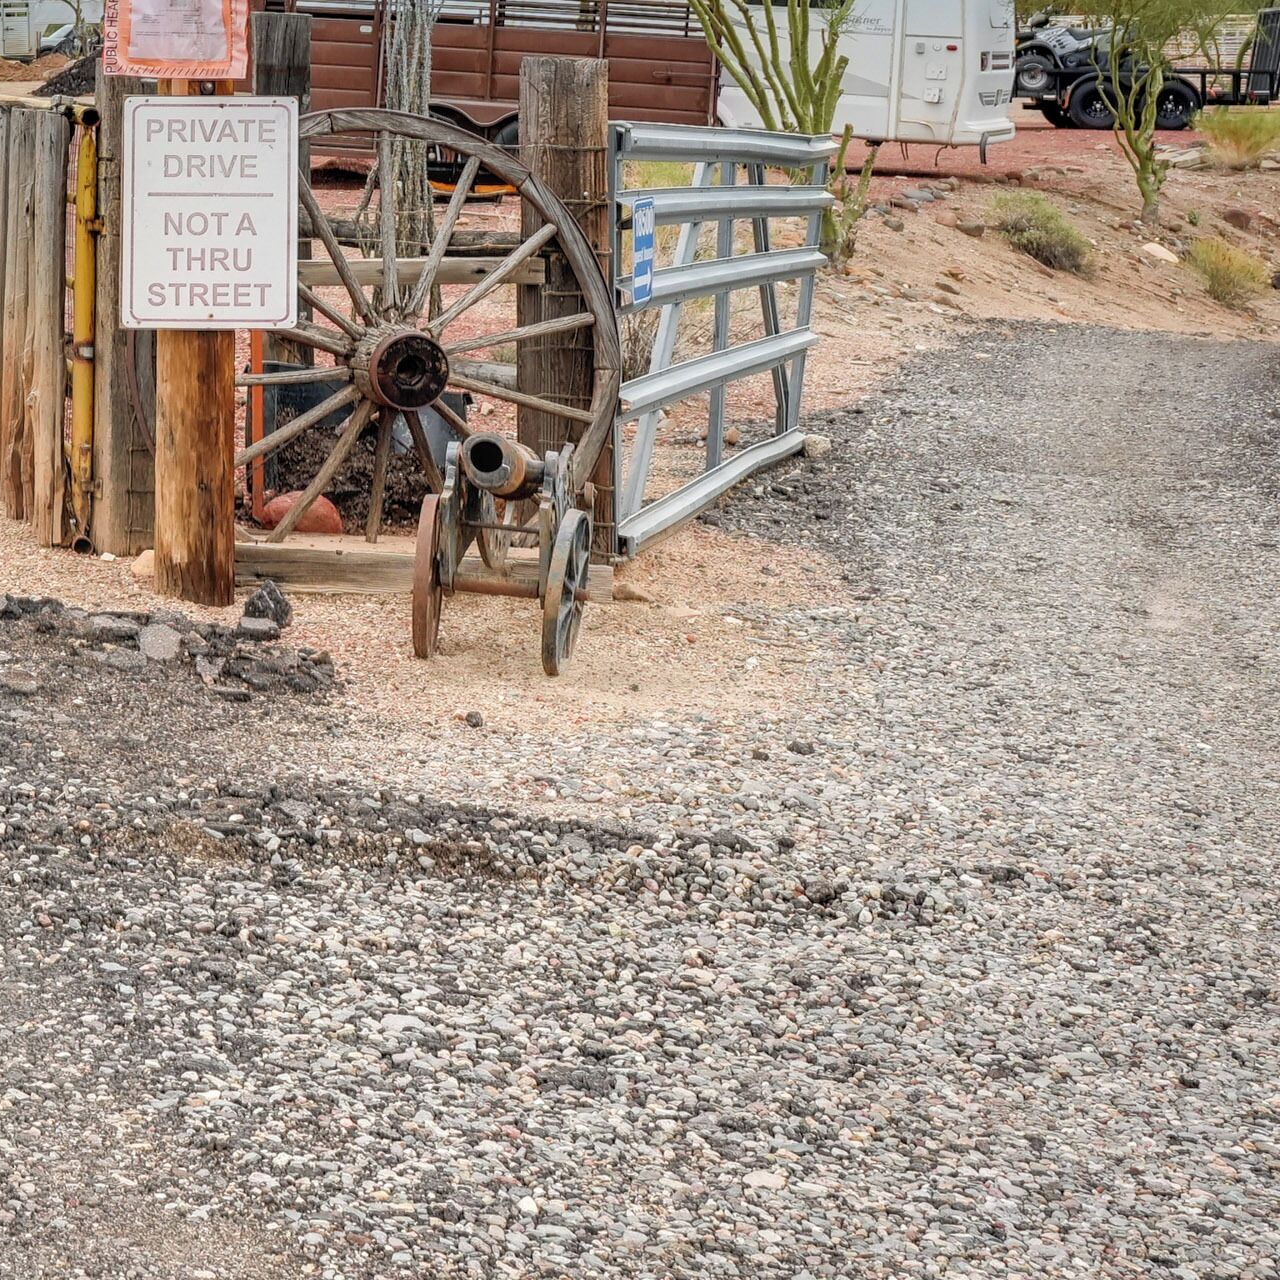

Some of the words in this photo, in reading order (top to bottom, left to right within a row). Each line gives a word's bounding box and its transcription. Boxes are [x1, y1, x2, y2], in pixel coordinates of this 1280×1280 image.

[105, 31, 118, 73] PUBLIC
[146, 119, 276, 143] PRIVATE
[163, 154, 258, 178] DRIVE
[164, 212, 229, 236] NOT
[235, 212, 257, 236] A
[166, 247, 252, 272] THRU
[147, 282, 272, 307] STREET
